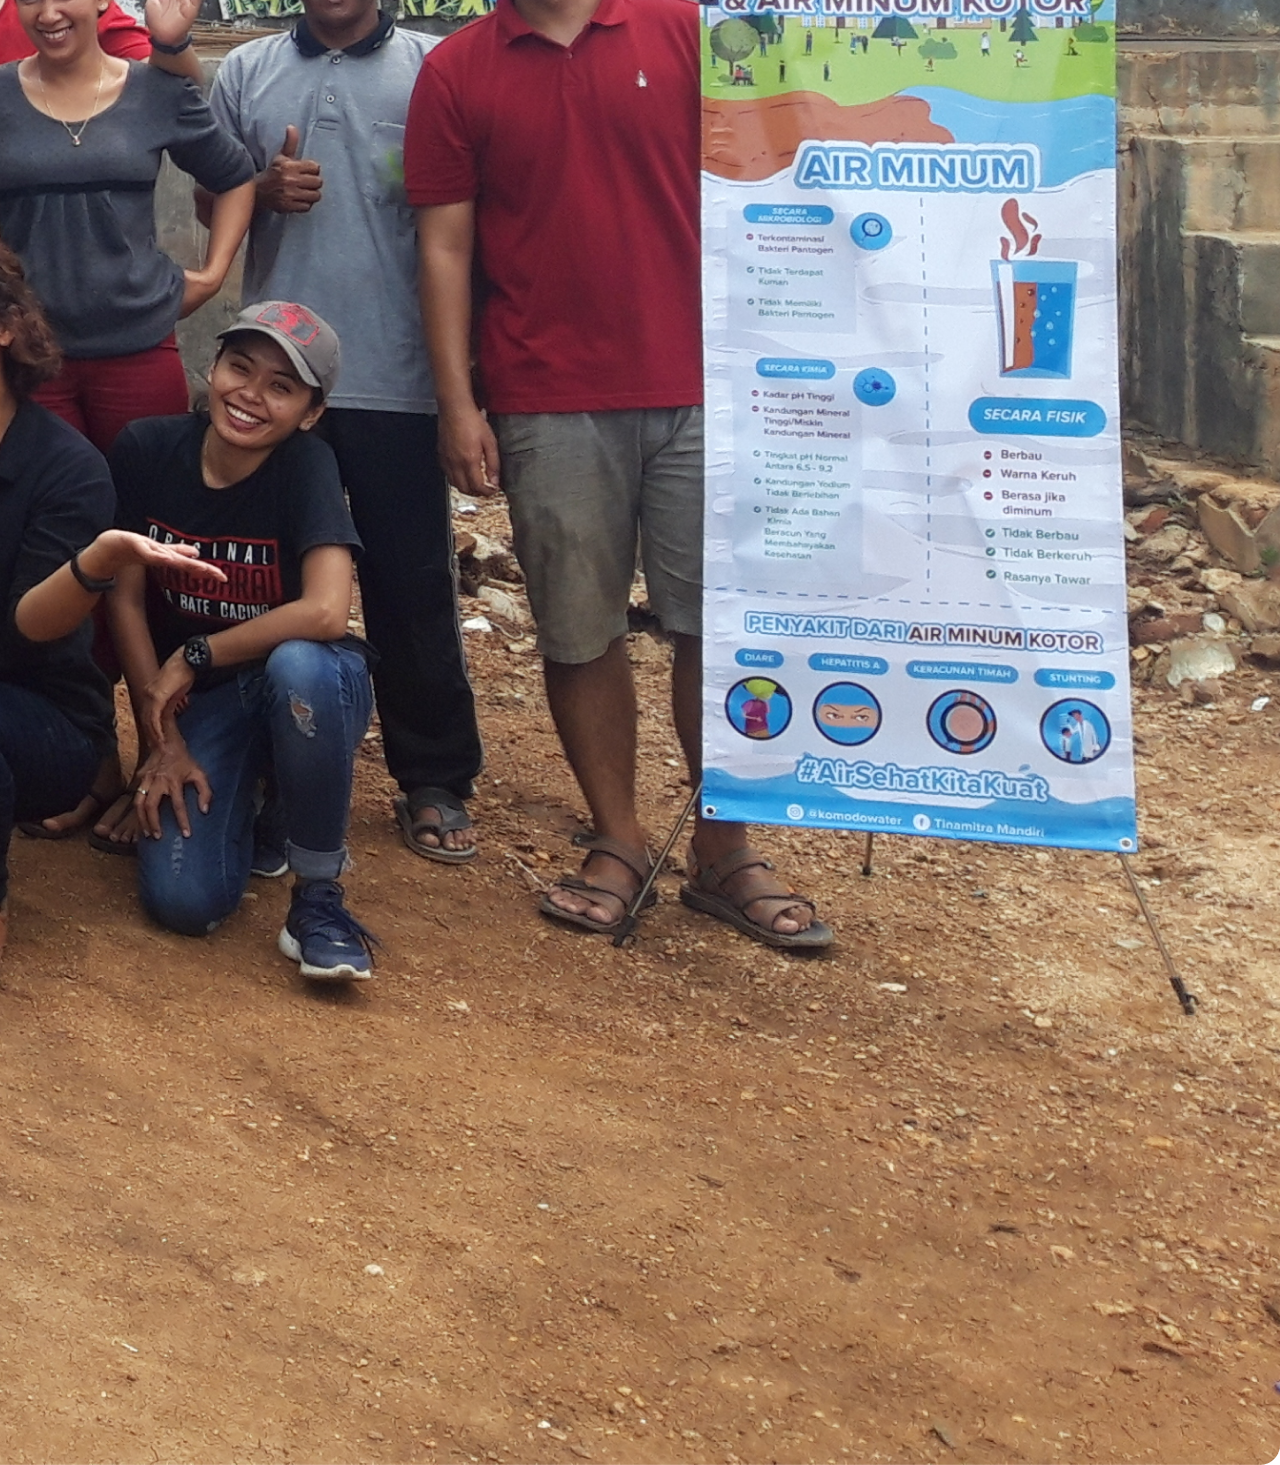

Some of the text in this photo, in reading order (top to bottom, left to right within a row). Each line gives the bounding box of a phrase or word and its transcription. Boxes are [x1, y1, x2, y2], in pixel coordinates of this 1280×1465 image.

[803, 154, 1025, 186] AIR MINUM
[772, 207, 808, 215] SECARA
[758, 233, 825, 242] Terkontaminasi
[758, 244, 789, 253] Bakteri
[758, 266, 824, 277] Tidak Terdapat
[758, 297, 781, 306] Tidak
[758, 309, 790, 317] Bakteri
[764, 364, 800, 373] SECARA
[763, 391, 835, 402] Kadar pH Tinggi
[763, 406, 850, 417] Kandungan Mineral
[984, 408, 1087, 423] SECARA FISIK
[764, 428, 851, 439] Kandungan Mineral
[764, 450, 848, 462] Tingkat pH Normal
[1001, 449, 1042, 461] Berbau
[765, 462, 794, 470] Antara
[1000, 469, 1077, 481] Warna Keruh
[765, 478, 851, 488] Kandungan Yodium
[766, 488, 789, 496] Tidak
[1001, 490, 1066, 503] Berasa jika
[765, 506, 789, 514] Tidak
[812, 509, 840, 517] Bahan
[1002, 506, 1052, 516] diminum
[804, 530, 827, 540] Yang
[1002, 527, 1079, 541] Tidak Berbau
[1003, 547, 1092, 561] Tidak Berkeruh
[1004, 571, 1091, 585] Rasanya Tawar
[180, 593, 210, 615] BATE
[749, 615, 1099, 650] PENYAKIT DARI AIR MINUM KOTOR
[744, 653, 775, 663] DIARE
[821, 658, 870, 669] HEPATITIS
[913, 665, 1011, 678] KERACUNAN TIMAH
[1050, 673, 1101, 684] STUNTING
[799, 758, 1049, 800] #AirSehatKitaKuat
[809, 808, 902, 826] @komodowater
[934, 818, 1045, 838] Tinamitra Mandiri
